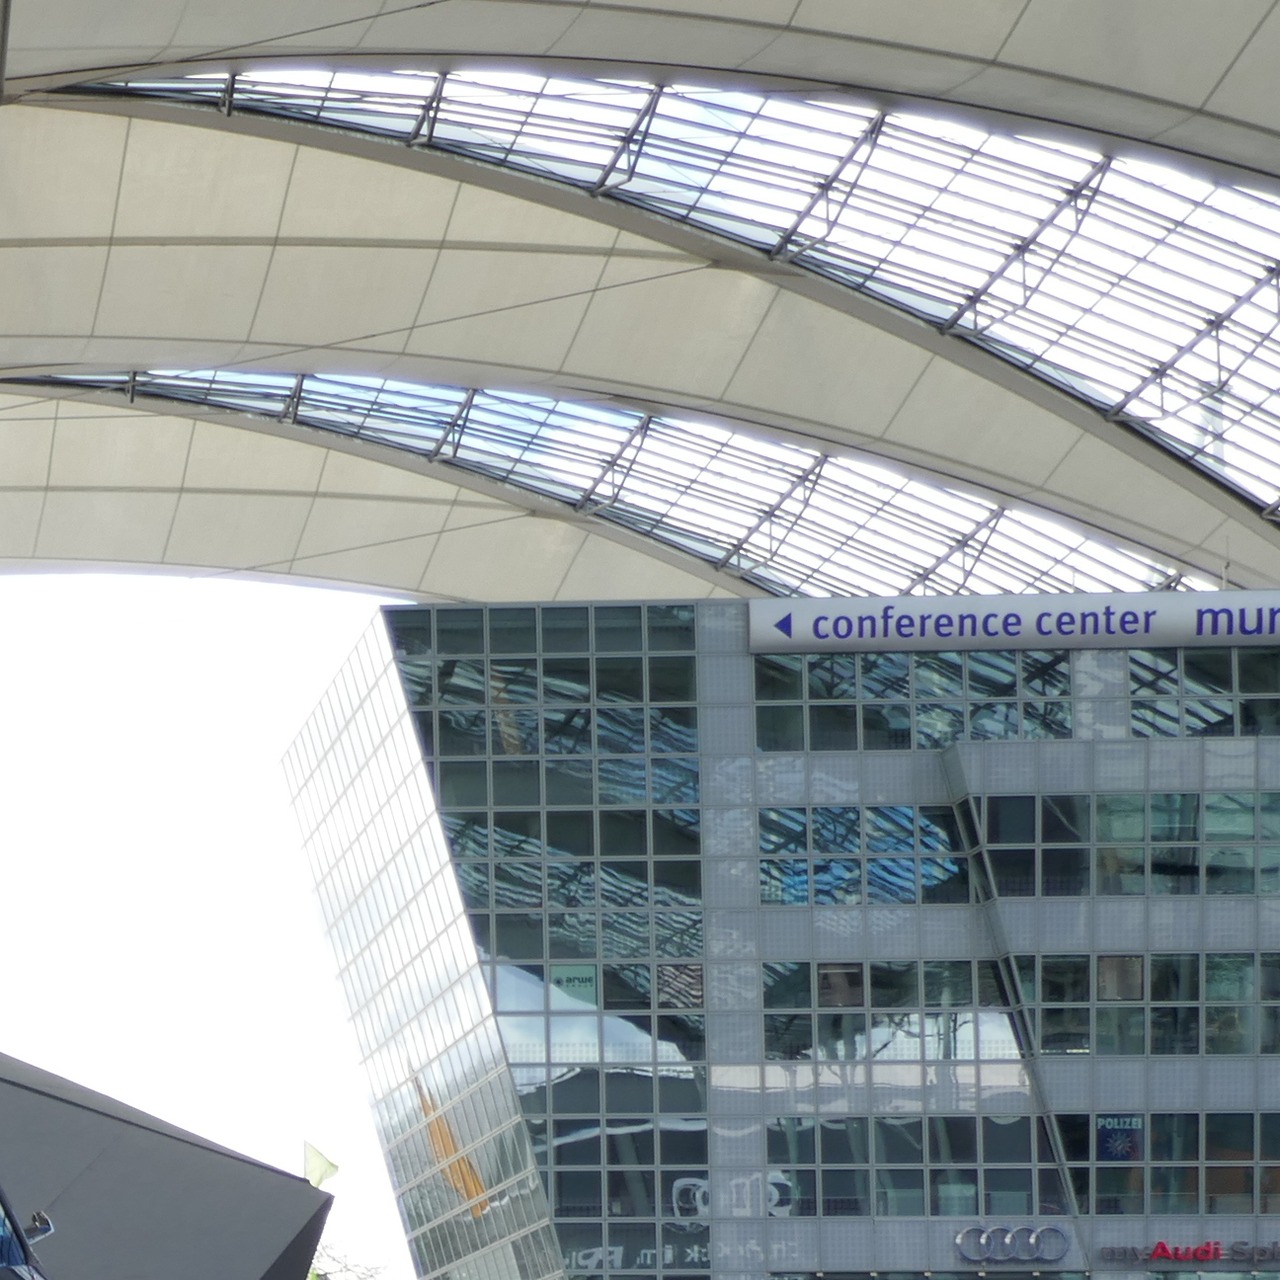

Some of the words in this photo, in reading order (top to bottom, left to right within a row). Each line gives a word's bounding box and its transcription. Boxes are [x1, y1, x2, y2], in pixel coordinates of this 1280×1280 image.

[812, 605, 1022, 639] conference
[1035, 604, 1157, 636] center
[1096, 1117, 1143, 1130] POLIZEI
